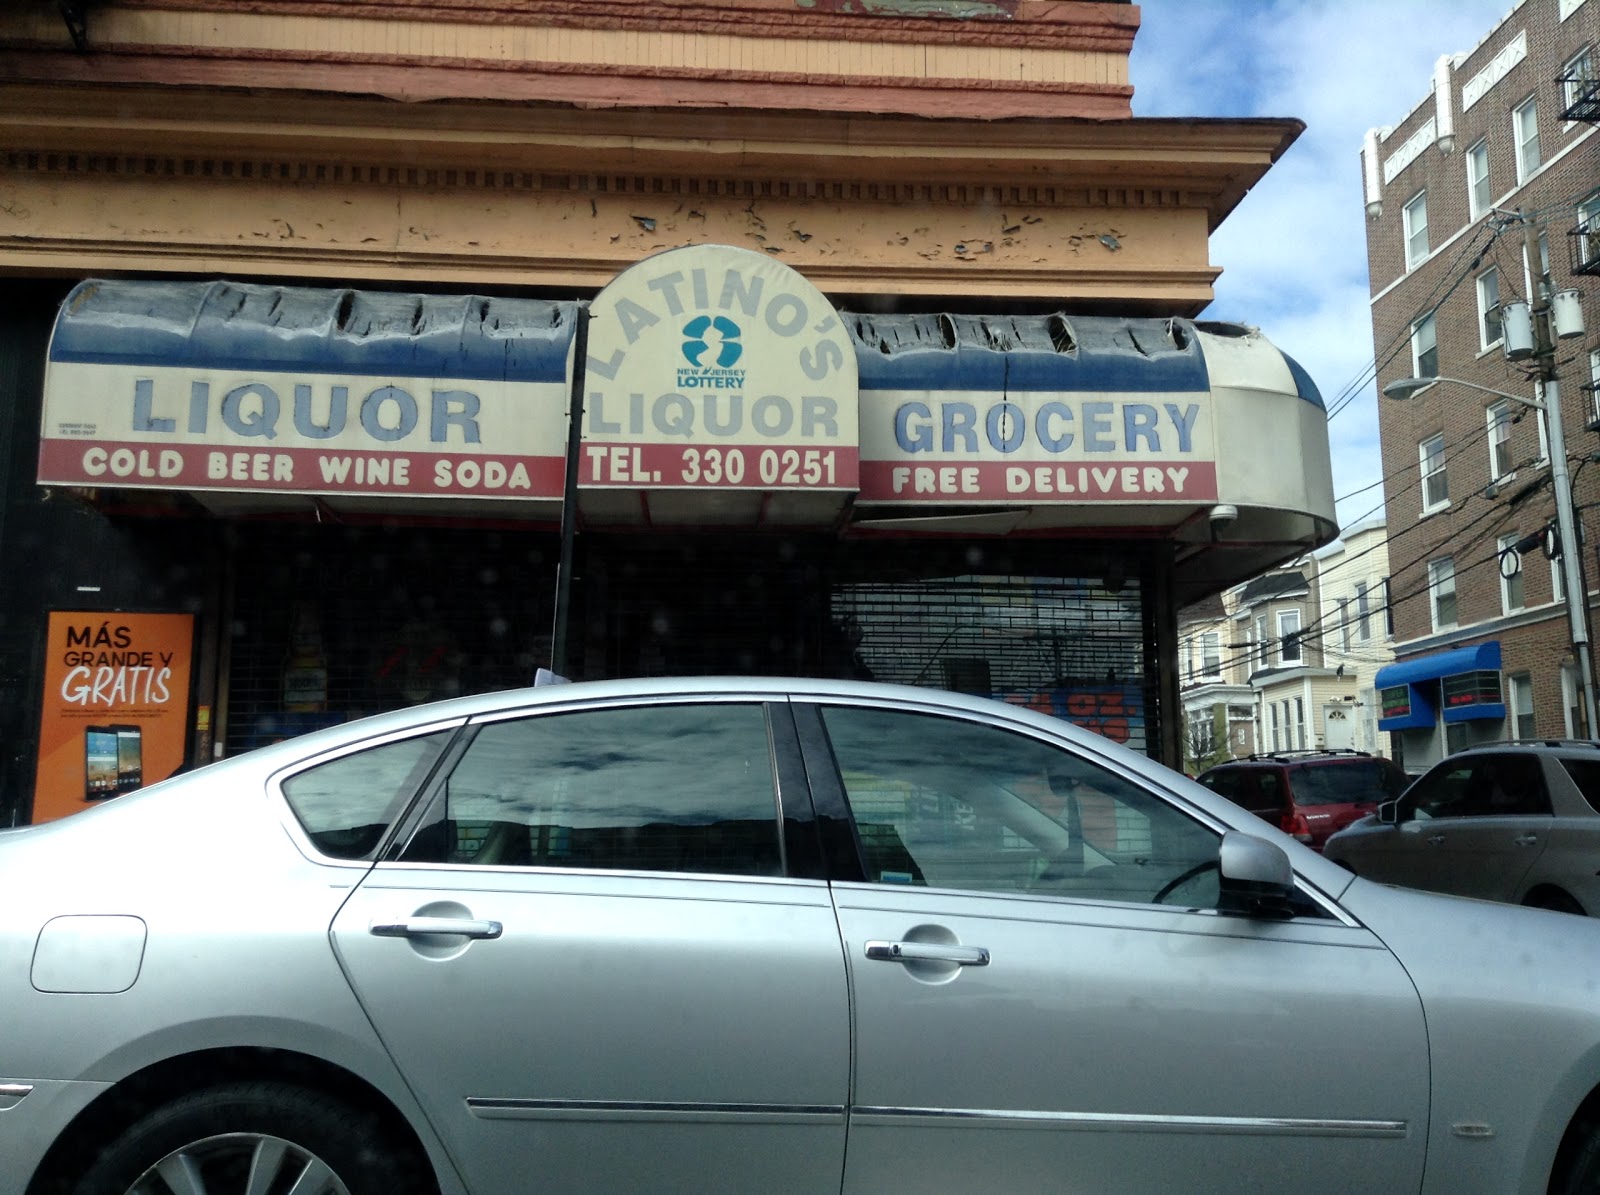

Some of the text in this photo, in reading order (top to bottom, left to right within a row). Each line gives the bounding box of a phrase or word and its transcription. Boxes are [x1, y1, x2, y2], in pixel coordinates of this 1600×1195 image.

[585, 268, 843, 381] LATINO'S
[677, 376, 744, 388] LOTTERY
[132, 378, 482, 444] LIQUOR
[588, 391, 839, 439] LIQUOR
[894, 401, 1199, 453] GROCERY
[82, 447, 532, 490] COLD BEER WINE SODA
[586, 446, 836, 485] TEL. 330 0251
[892, 467, 1189, 494] FREE DELIVERY
[66, 620, 132, 649] MÁS
[63, 651, 174, 668] GRANDE Y
[61, 665, 172, 707] GRATIS
